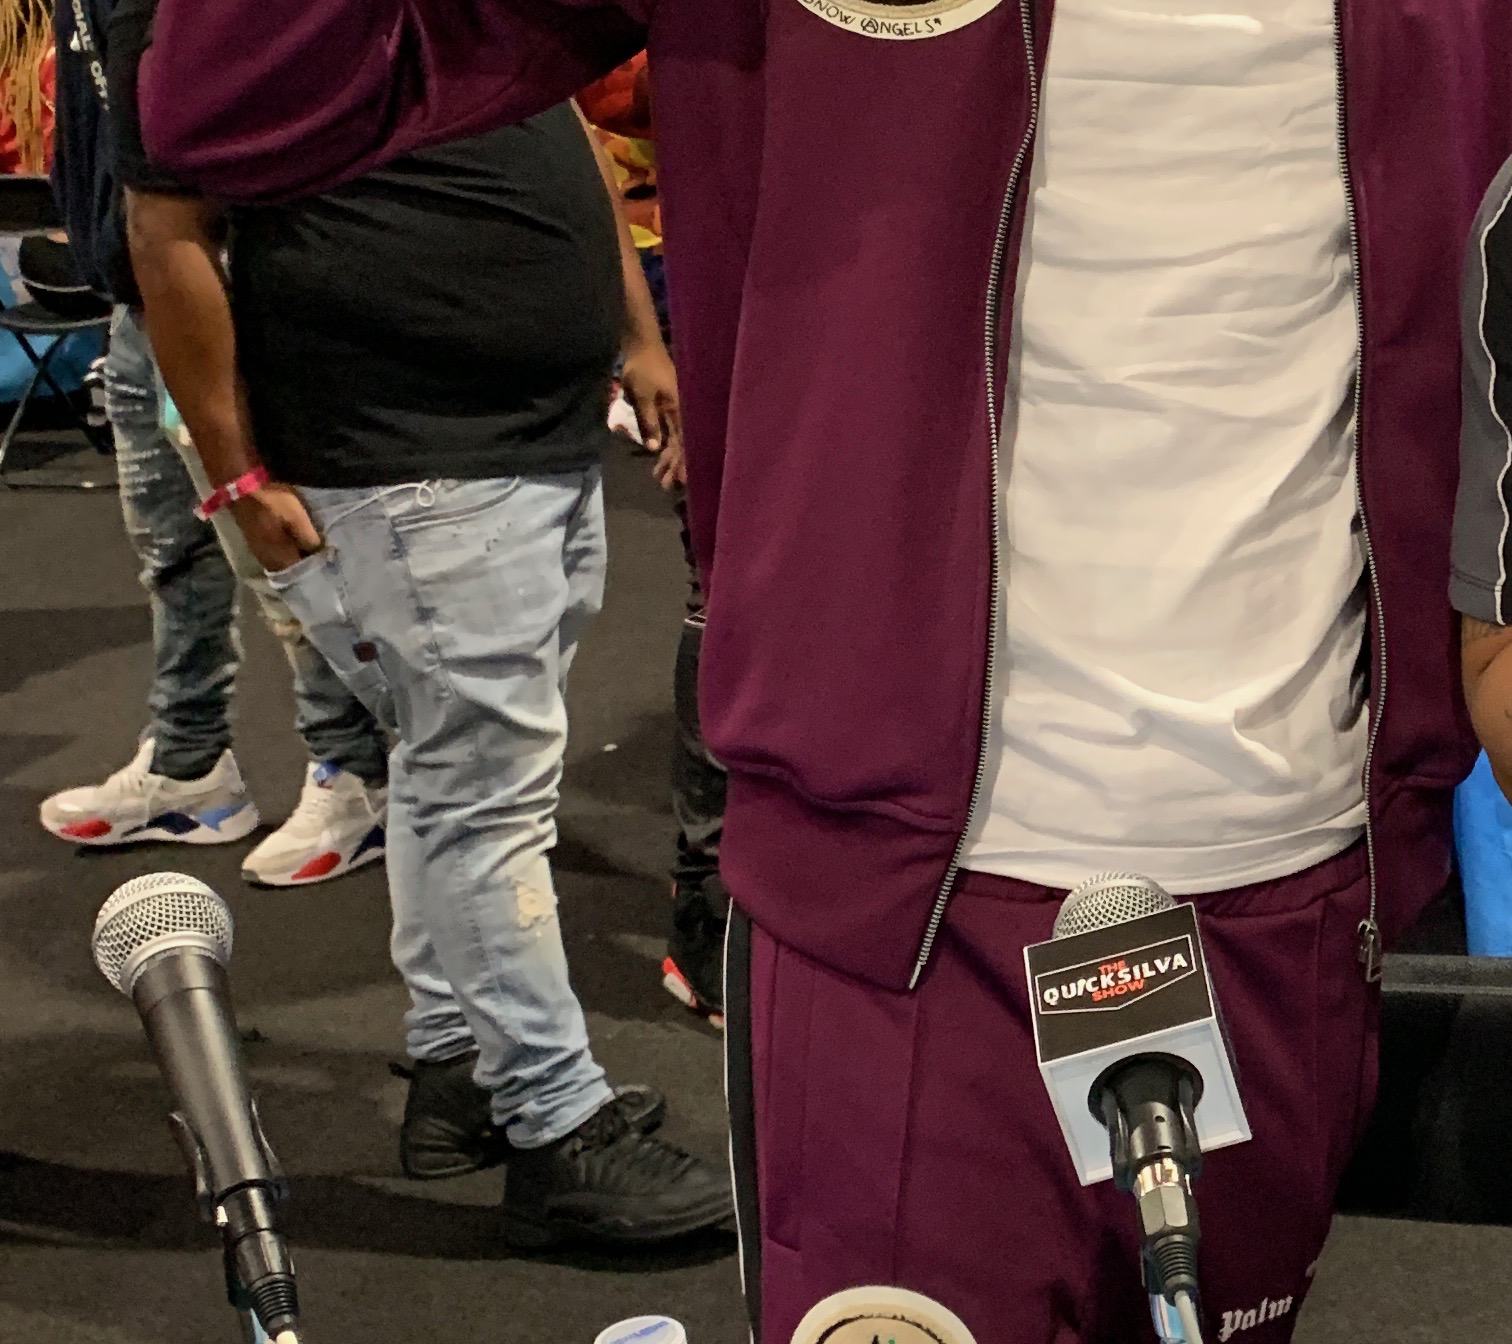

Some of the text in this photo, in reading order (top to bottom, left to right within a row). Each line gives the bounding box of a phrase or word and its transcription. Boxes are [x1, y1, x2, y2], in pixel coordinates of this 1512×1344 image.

[1098, 959, 1127, 975] THE
[1091, 979, 1146, 1002] SHOW
[1217, 1293, 1294, 1343] Palm
